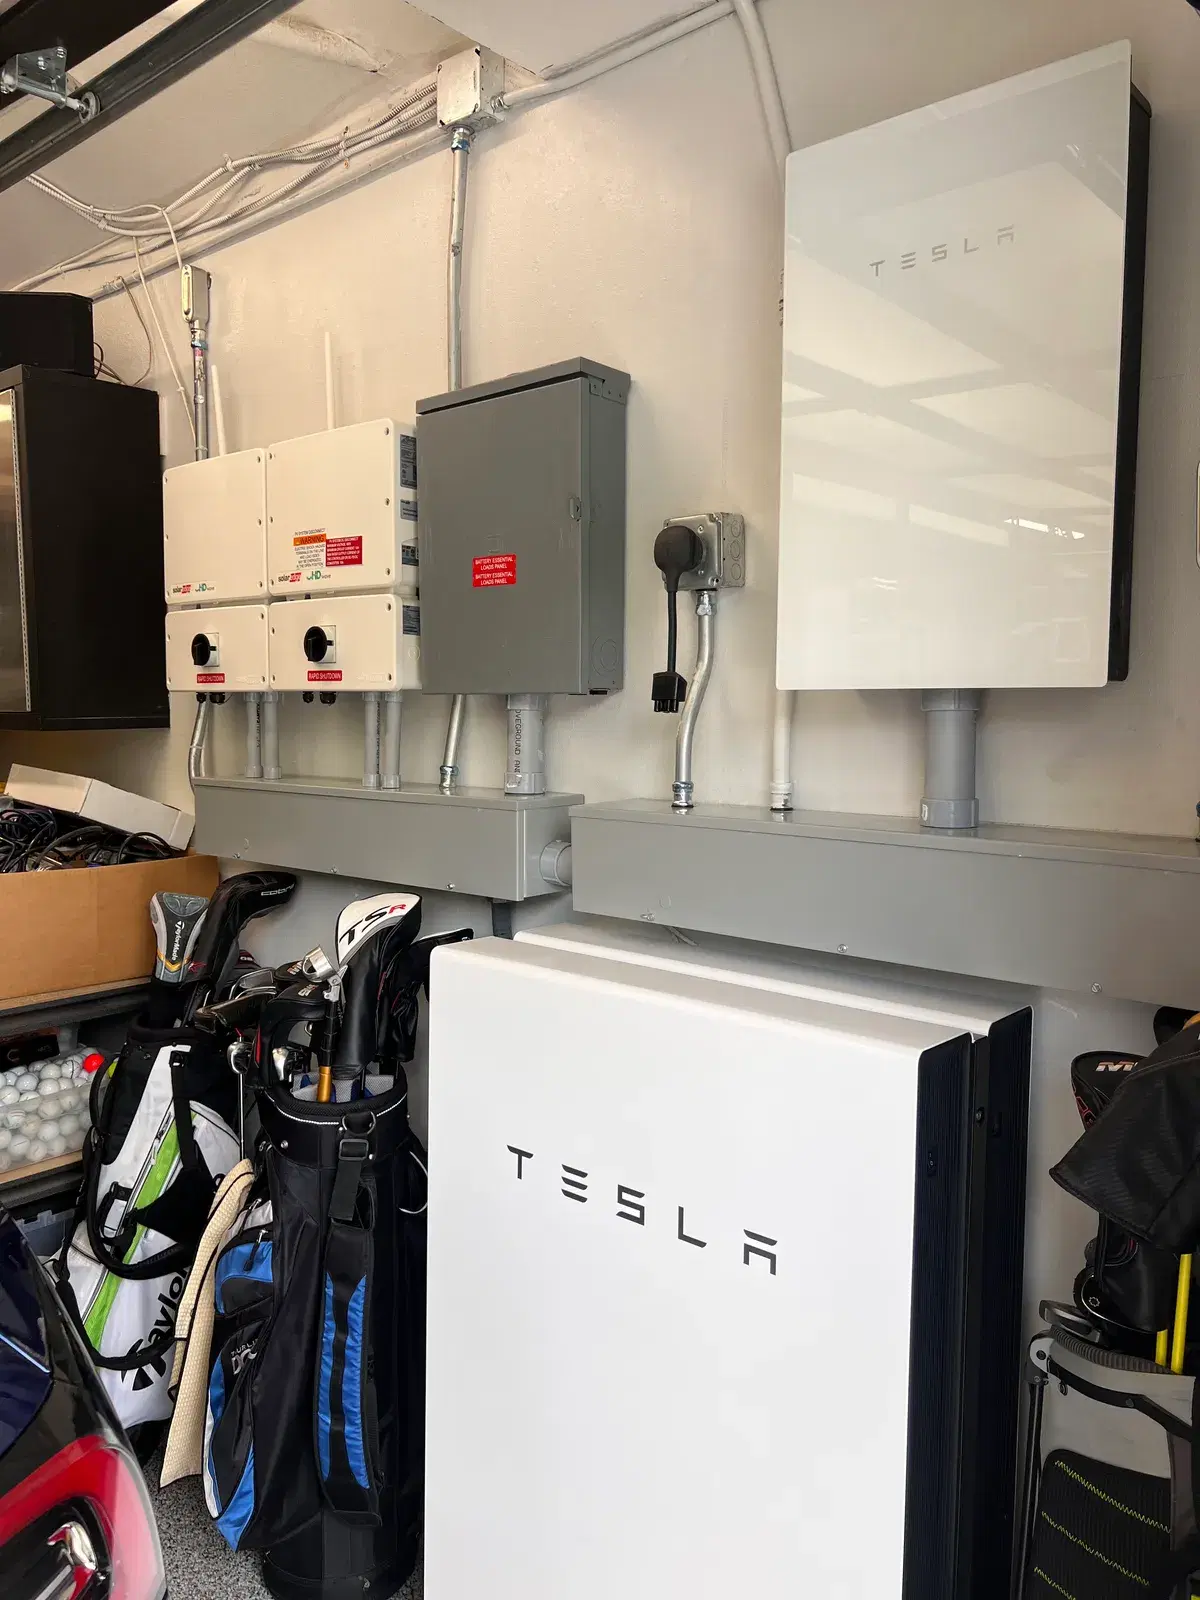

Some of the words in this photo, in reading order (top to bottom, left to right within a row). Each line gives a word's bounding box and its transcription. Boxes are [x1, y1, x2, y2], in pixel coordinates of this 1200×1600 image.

[869, 224, 1014, 277] TESLA
[300, 535, 324, 544] WARNING
[172, 920, 185, 961] TaylorMade
[338, 904, 406, 946] TSR
[506, 1144, 778, 1276] TESLA
